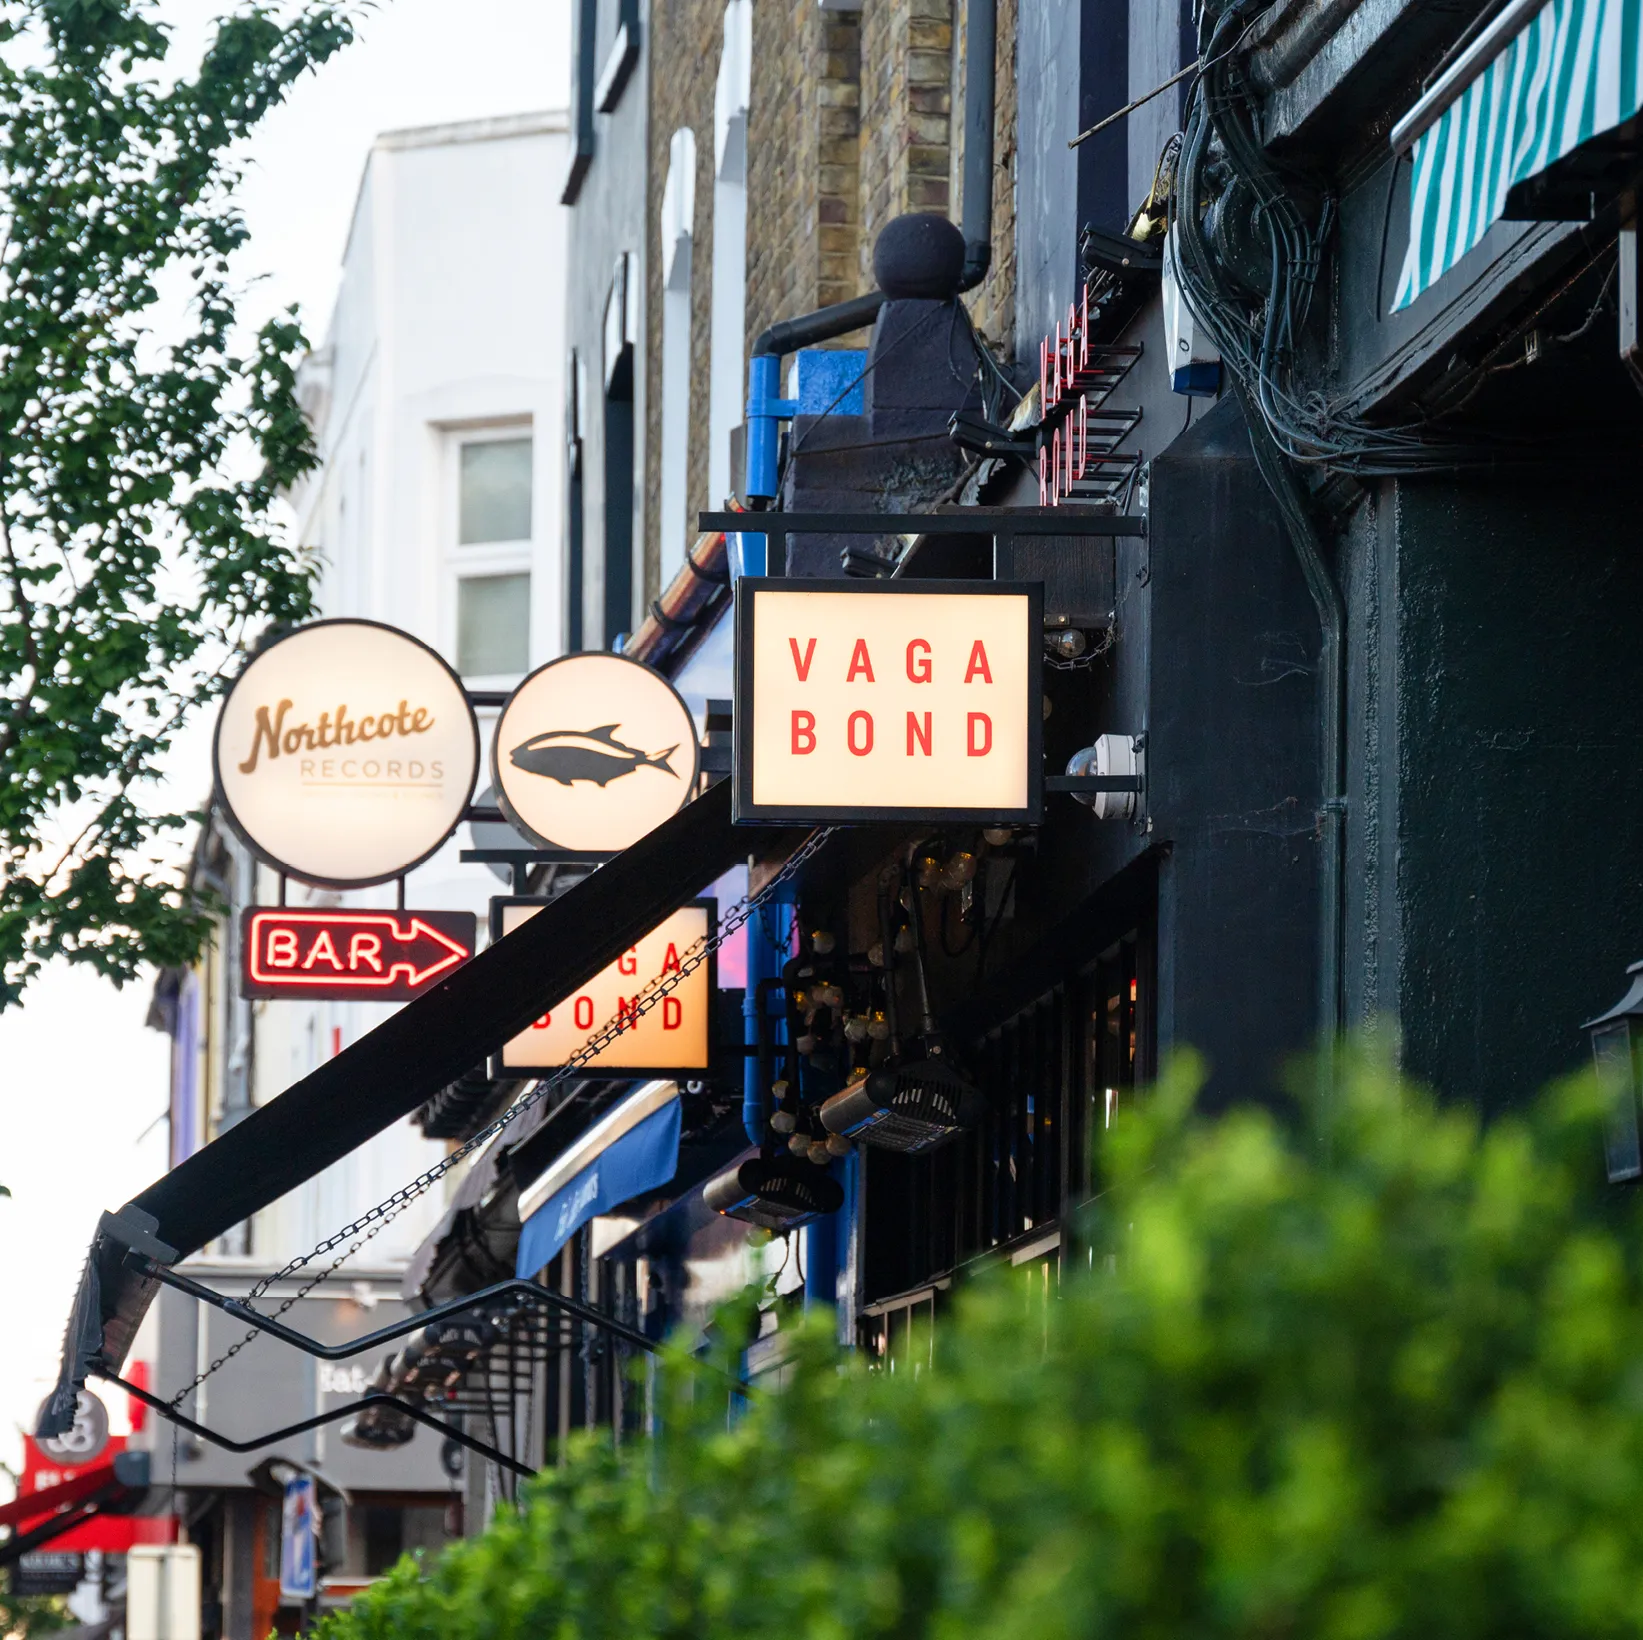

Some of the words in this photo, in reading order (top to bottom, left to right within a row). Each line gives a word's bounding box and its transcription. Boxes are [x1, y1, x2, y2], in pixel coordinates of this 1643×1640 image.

[788, 637, 993, 684] VAGA
[238, 699, 435, 774] Northcote
[791, 710, 993, 757] BOND
[300, 759, 444, 779] RECORDS
[267, 930, 382, 972] BAR
